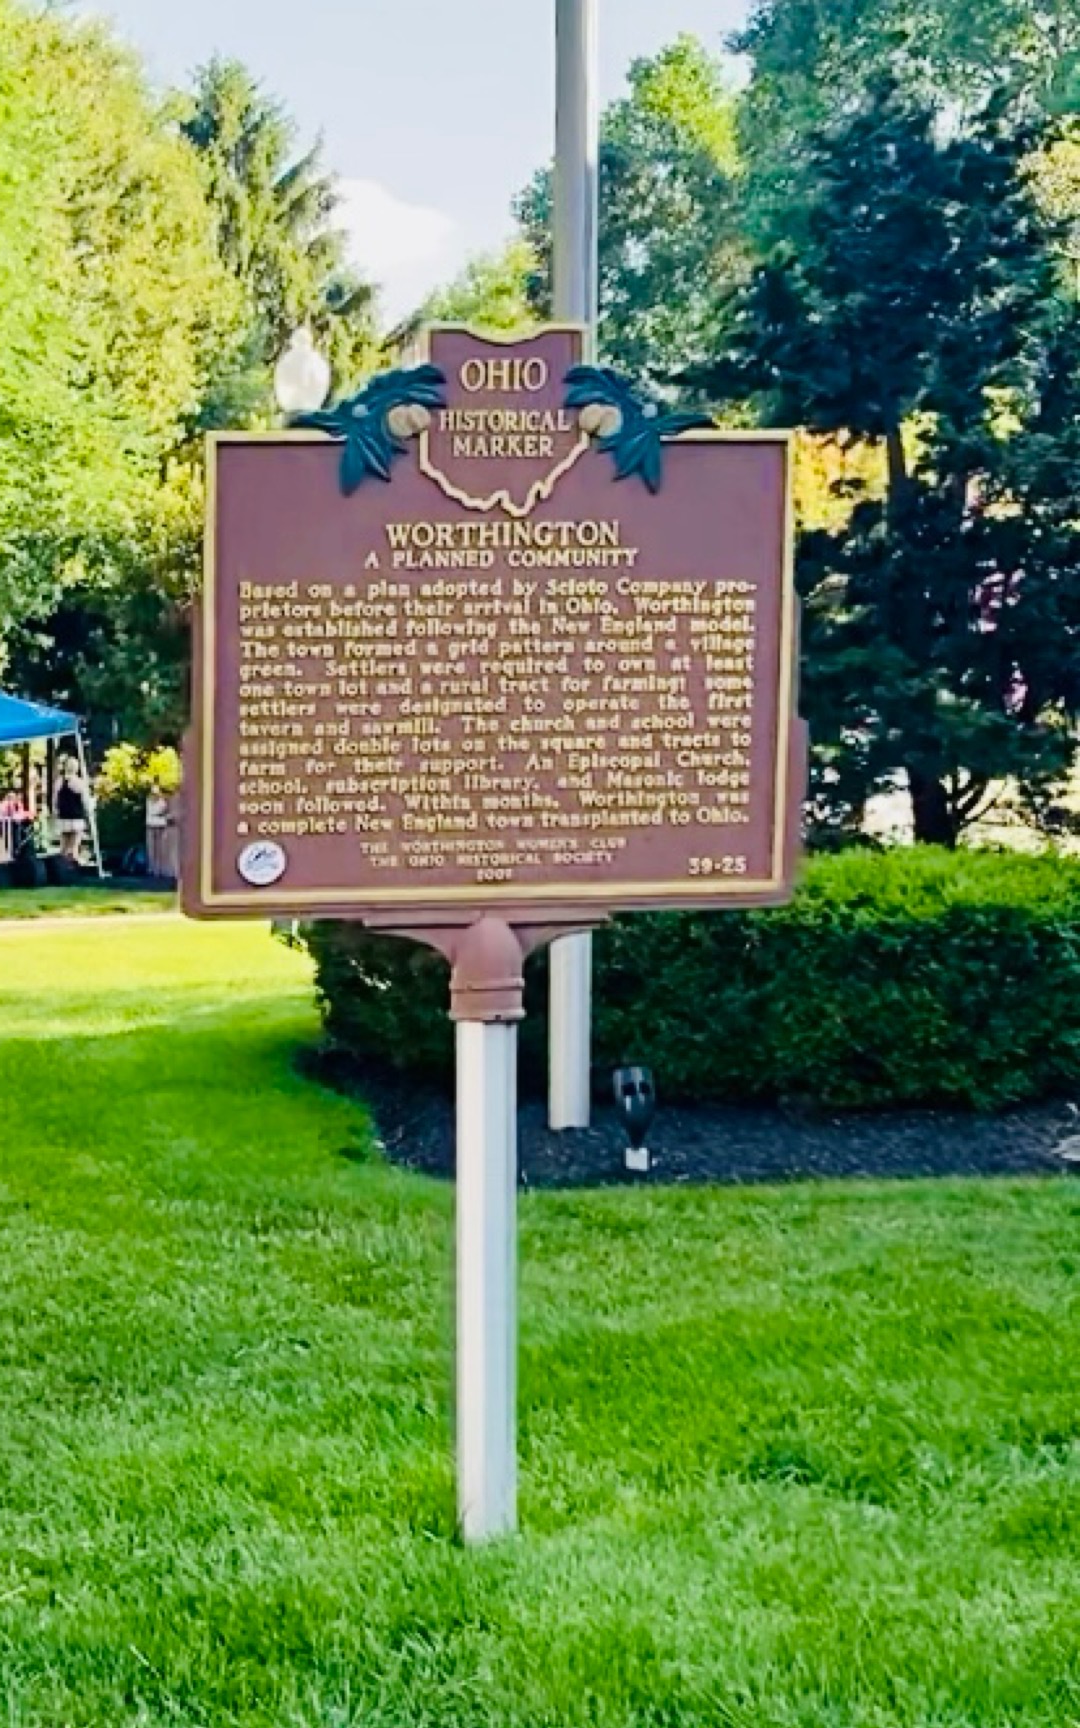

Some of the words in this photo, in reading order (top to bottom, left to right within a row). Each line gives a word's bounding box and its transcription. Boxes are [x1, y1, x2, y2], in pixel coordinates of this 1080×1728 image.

[460, 358, 548, 392] OHIO
[439, 409, 570, 431] HISTORICAL
[453, 435, 553, 457] MARKER
[385, 521, 619, 548] WORTHINGTON
[365, 552, 379, 569] A
[393, 550, 495, 568] PLANNED
[508, 548, 638, 567] COMMUNITY
[239, 581, 298, 598] Based
[308, 584, 332, 598] on
[344, 585, 356, 598] a
[368, 580, 410, 600] plan
[421, 579, 502, 600] adopted
[513, 578, 537, 596] by
[545, 578, 608, 595] Scioto
[617, 576, 707, 597] Company
[715, 580, 757, 595] pro-
[239, 601, 321, 621] prietors
[330, 601, 396, 617] before
[405, 600, 455, 616] their
[463, 595, 530, 616] arrival
[539, 597, 559, 614] in
[633, 595, 757, 616] Worthington
[239, 624, 275, 637] was
[282, 620, 397, 637] established
[405, 618, 497, 639] following
[509, 619, 540, 634] the
[552, 618, 591, 633] New
[601, 615, 676, 637] England
[239, 641, 280, 658] The
[288, 642, 334, 657] town
[344, 639, 416, 657] formed
[427, 642, 439, 655] a
[447, 639, 488, 659] grid
[498, 638, 574, 658] pattern
[586, 635, 653, 653] around
[690, 634, 754, 654] village
[325, 659, 406, 676] Settlers
[420, 661, 465, 674] were
[480, 656, 568, 679] required
[583, 657, 605, 671] to
[618, 658, 656, 671] own
[671, 657, 691, 671] at
[706, 654, 754, 671] least
[239, 682, 275, 697] one
[284, 680, 331, 696] town
[338, 678, 369, 694] lot
[375, 678, 413, 694] and
[421, 681, 433, 693] a
[440, 677, 488, 694] rural
[498, 675, 549, 693] tract
[561, 675, 591, 692] for
[704, 677, 754, 690] some
[239, 700, 316, 716] settlers
[335, 702, 382, 715] were
[399, 697, 507, 717] designated
[524, 697, 546, 712] to
[562, 695, 639, 714] operate
[659, 694, 690, 710] the
[707, 692, 754, 708] first
[239, 720, 303, 737] tavern
[314, 718, 350, 736] and
[461, 716, 499, 734] The
[510, 714, 574, 732] church
[586, 713, 620, 729] and
[630, 711, 694, 729] school
[706, 715, 752, 728] were
[239, 738, 322, 759] assigned
[333, 737, 402, 754] double
[411, 736, 451, 753] lots
[461, 738, 486, 752] on
[498, 735, 530, 751] the
[540, 736, 606, 754] square
[617, 733, 653, 749] and
[662, 733, 720, 749] tracts
[731, 732, 752, 747] to
[239, 760, 286, 776] farm
[304, 758, 336, 775] for
[354, 757, 403, 774] their
[525, 753, 553, 771] An
[567, 751, 661, 772] Episcopal
[325, 775, 452, 794] subscription
[557, 772, 592, 788] and
[607, 770, 684, 788] Masonic
[697, 769, 750, 789] lodge
[239, 801, 284, 814] soon
[404, 794, 470, 811] Within
[578, 791, 700, 810] Worthington
[716, 792, 749, 805] was
[237, 821, 249, 834] a
[257, 817, 347, 836] complete
[354, 813, 395, 831] New
[402, 811, 478, 834] England
[486, 811, 534, 828] town
[541, 808, 663, 830] transplanted
[670, 808, 690, 825] to
[360, 842, 389, 854] THE
[401, 839, 504, 852] WORTHINGTON
[590, 836, 627, 849] CLUB
[371, 854, 398, 867] THE
[409, 854, 445, 867] OHIO
[456, 852, 541, 866] HISTORICAL
[553, 851, 612, 864] SOCIETY
[688, 857, 747, 875] 39-25
